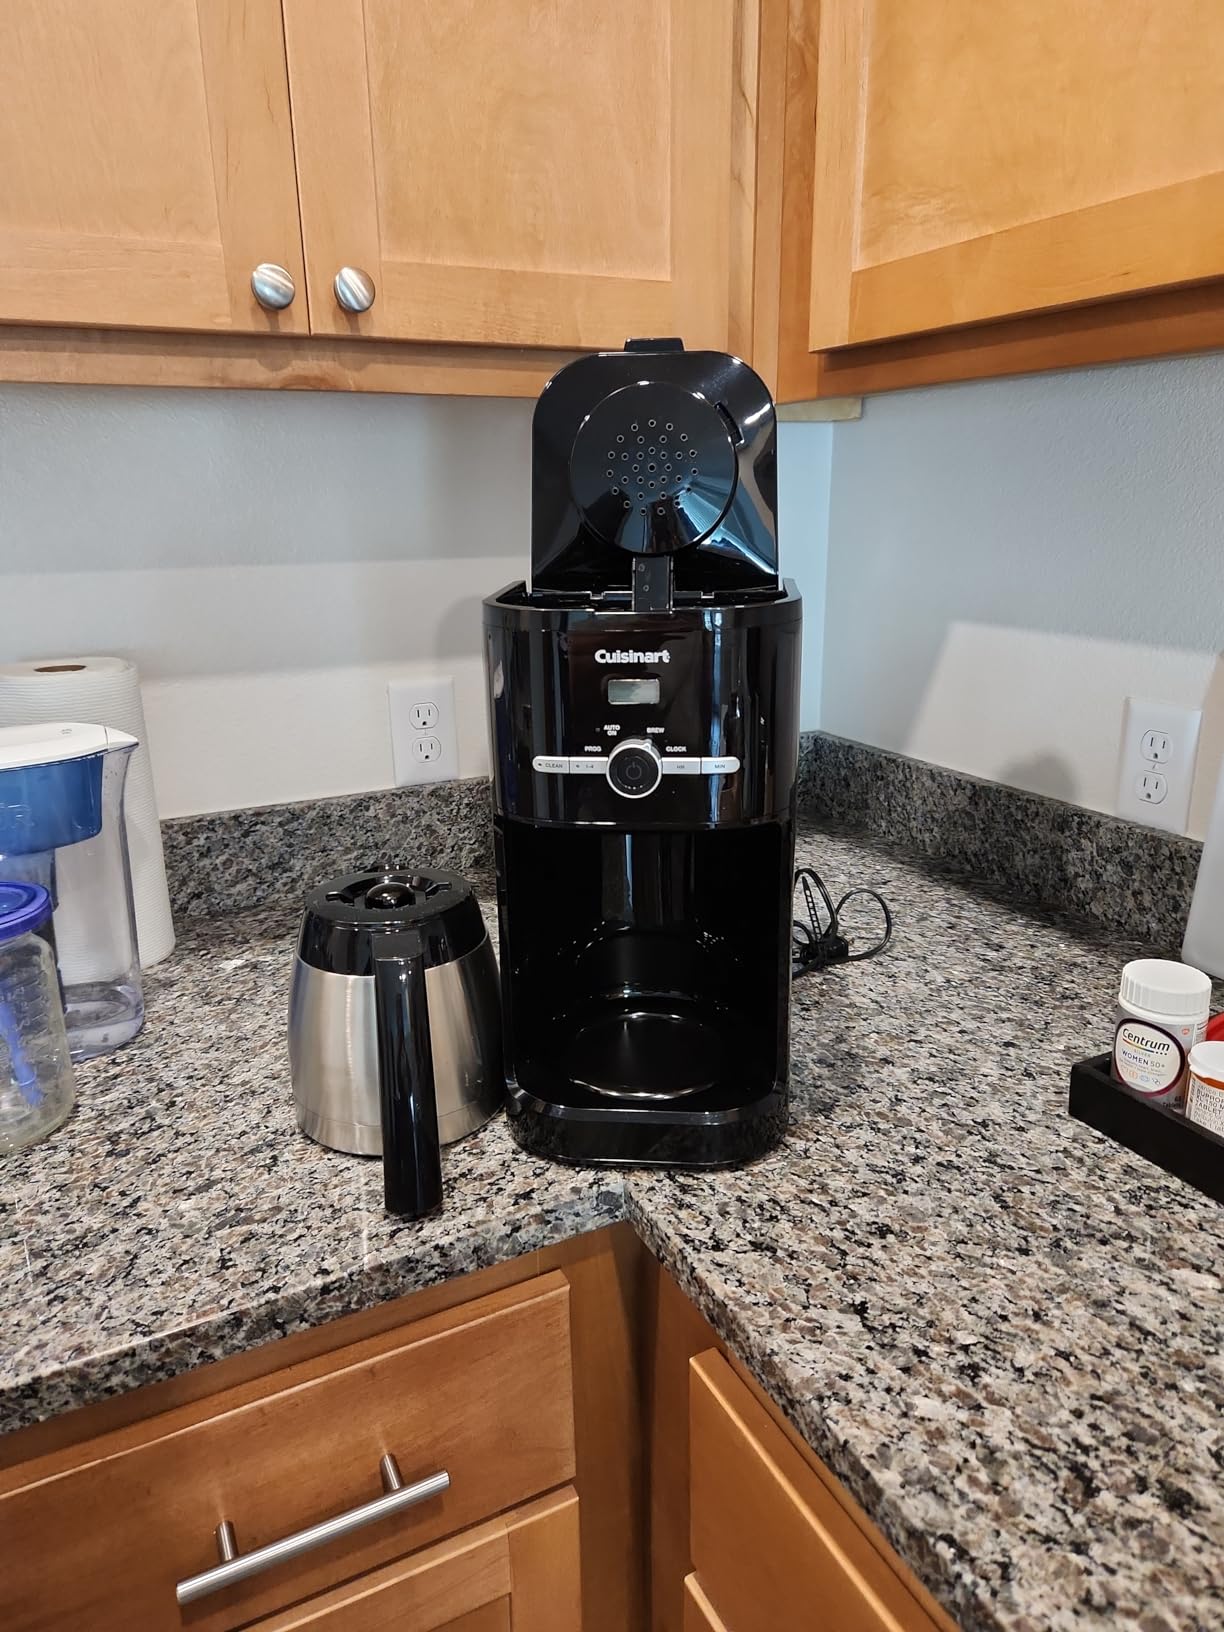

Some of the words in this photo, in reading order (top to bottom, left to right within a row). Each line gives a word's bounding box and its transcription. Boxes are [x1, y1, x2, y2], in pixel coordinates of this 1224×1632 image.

[594, 649, 671, 663] Cuisinart
[1122, 1028, 1170, 1052] Centrum
[1121, 1049, 1149, 1066] WOMEN
